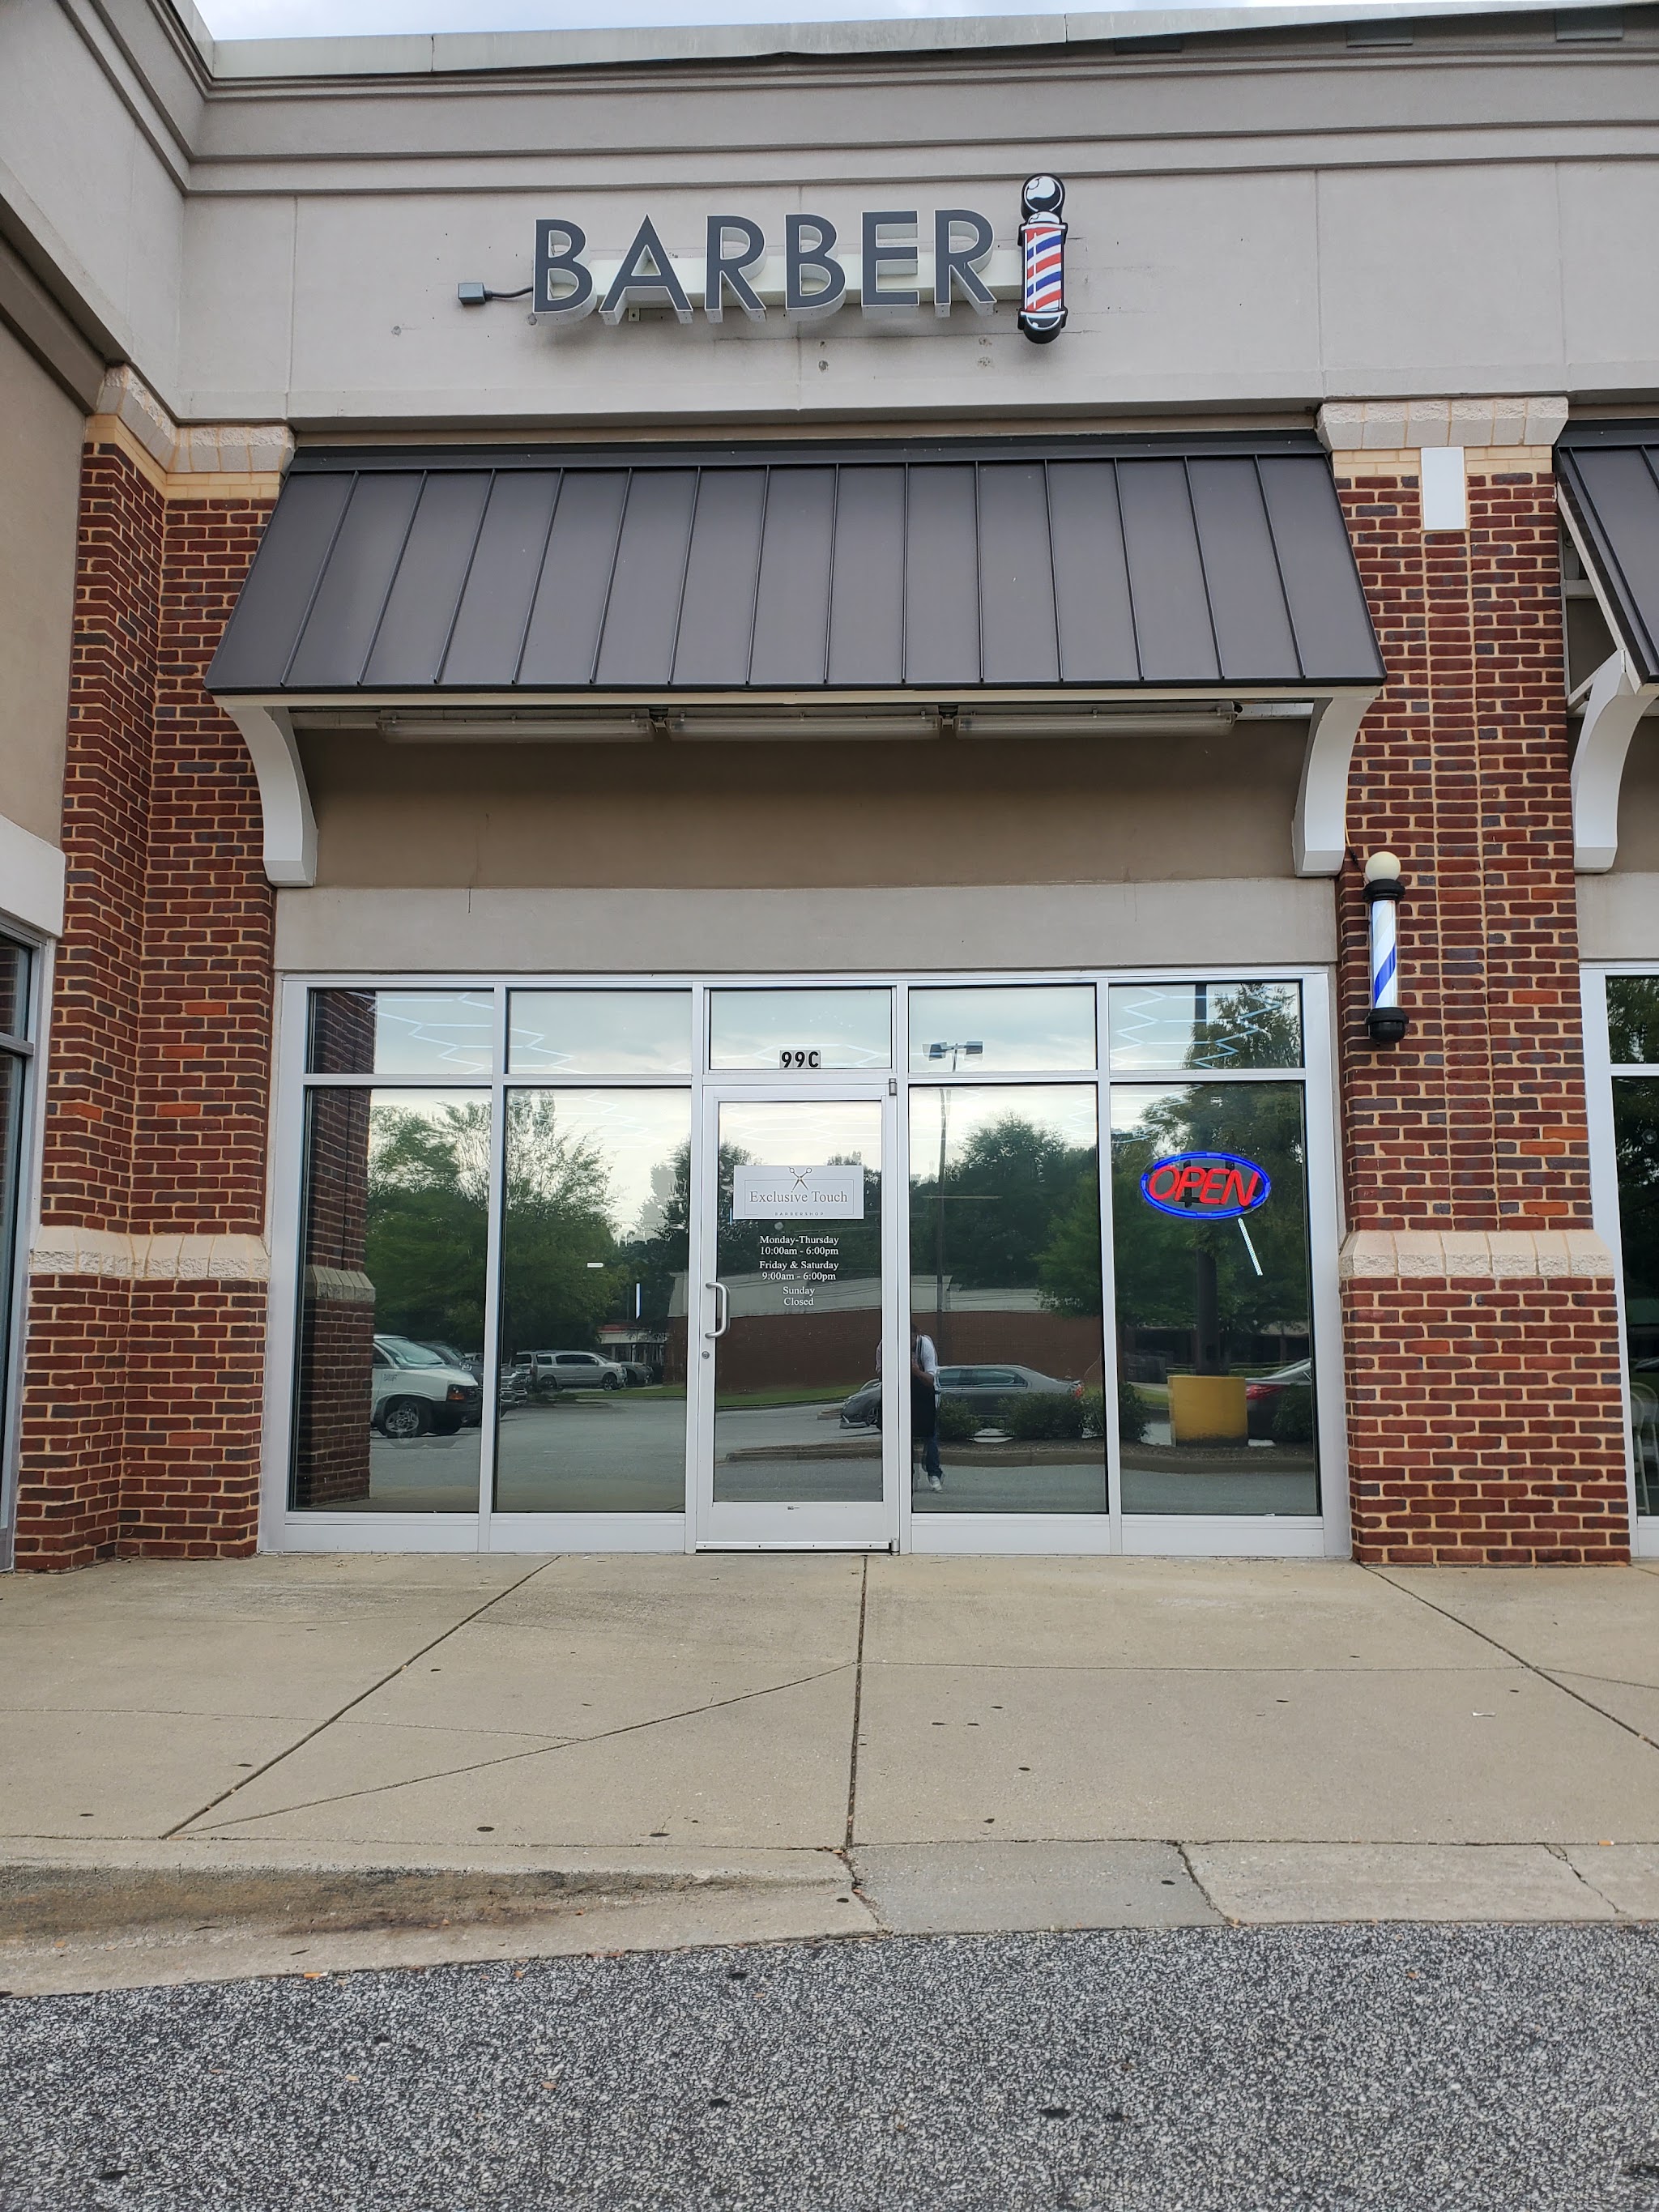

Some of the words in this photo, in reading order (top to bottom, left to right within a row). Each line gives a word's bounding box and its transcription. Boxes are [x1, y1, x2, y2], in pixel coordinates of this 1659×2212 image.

[533, 209, 997, 323] BARBER
[781, 1051, 819, 1068] 99C
[1148, 1165, 1260, 1207] OPEN
[749, 1191, 808, 1203] Exclusive
[811, 1191, 848, 1203] Touch
[759, 1235, 839, 1246] Monday-Thursday
[761, 1246, 798, 1255] 10:00am
[805, 1246, 839, 1256] 6:00pm
[759, 1260, 787, 1271] Friday
[790, 1260, 799, 1269] &
[800, 1260, 839, 1271] Saturday
[761, 1272, 795, 1281] 9:00am
[803, 1272, 837, 1282] 6:00pm
[783, 1285, 816, 1297] Sunday
[783, 1297, 814, 1306] Closed
